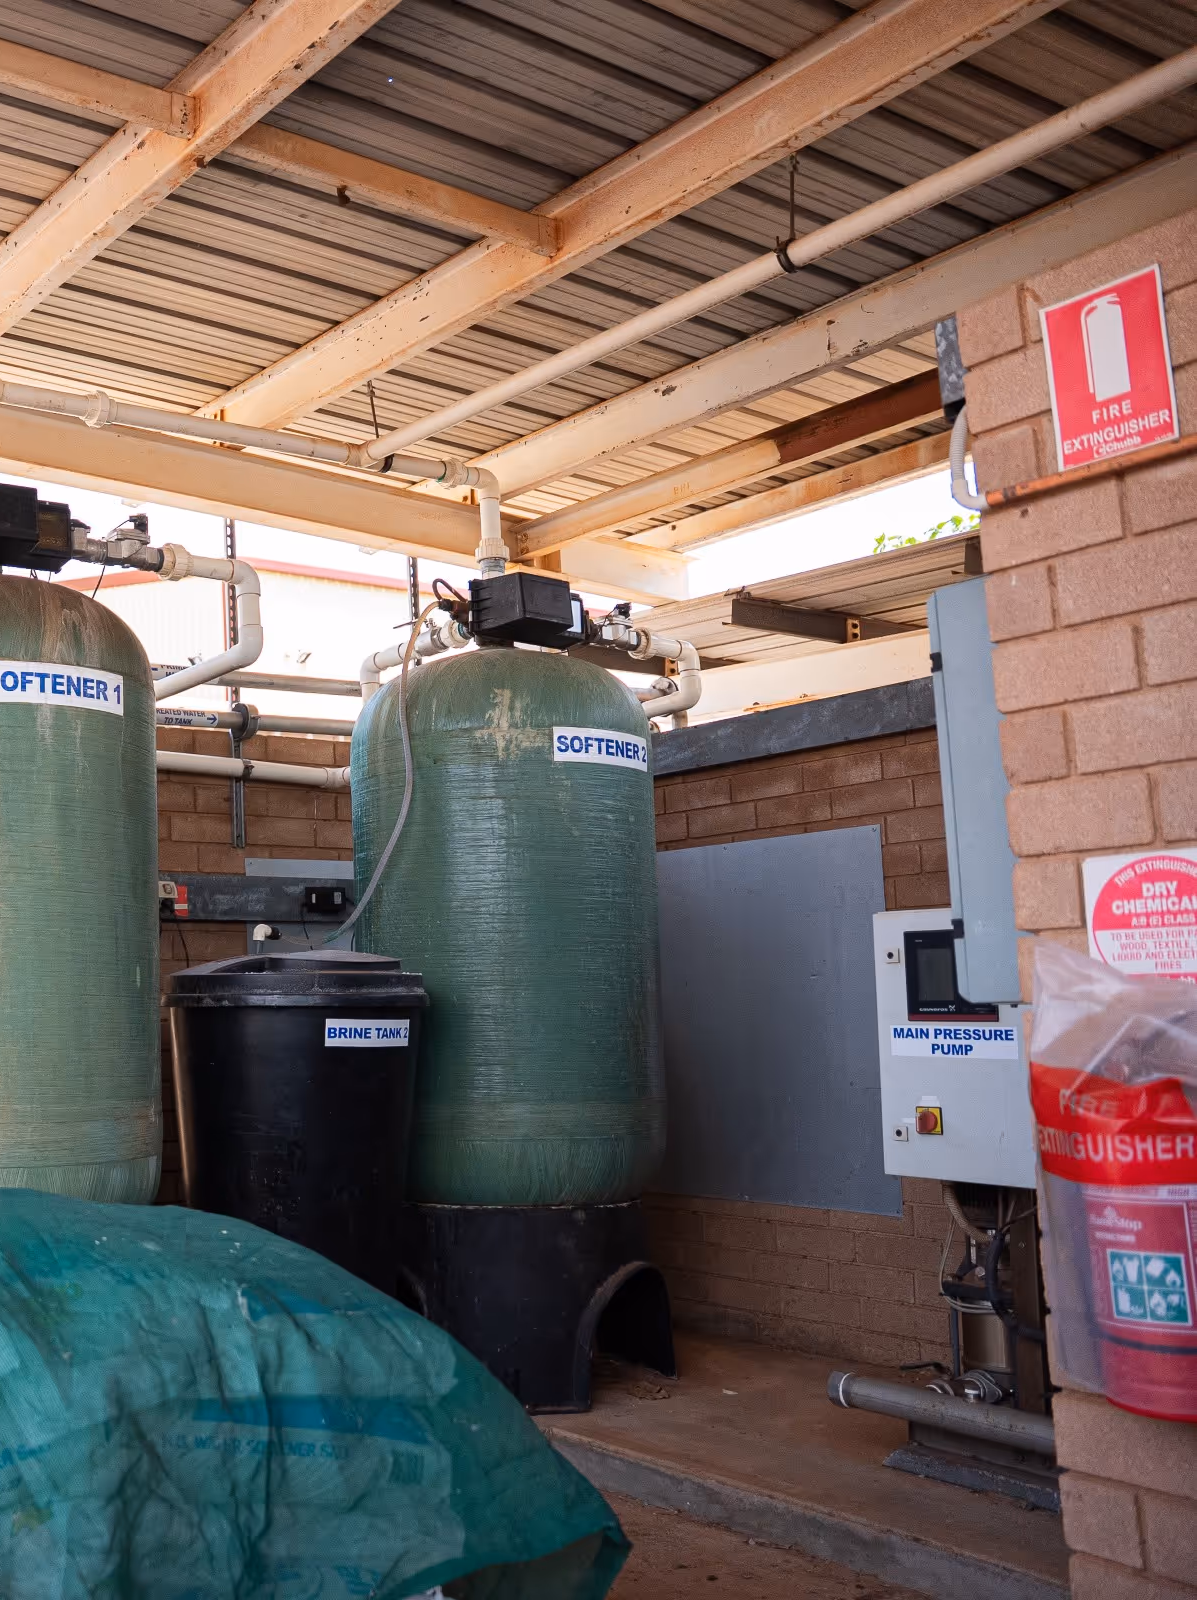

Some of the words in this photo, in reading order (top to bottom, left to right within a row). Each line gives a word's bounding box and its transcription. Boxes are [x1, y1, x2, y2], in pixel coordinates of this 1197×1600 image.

[1092, 399, 1133, 425] FIRE
[1063, 409, 1171, 455] EXTINGUISHER
[113, 684, 121, 705] 1
[156, 708, 181, 716] REATED
[183, 709, 206, 717] WATER
[174, 717, 193, 725] TANK
[556, 735, 640, 761] SOFTENER
[641, 745, 647, 764] 2
[1114, 867, 1136, 888] THIS
[1142, 880, 1178, 897] DRY
[1164, 913, 1196, 924] CLASS
[1110, 932, 1122, 941] TO
[1125, 931, 1136, 941] BE
[1139, 930, 1163, 940] USED
[1165, 929, 1184, 939] FOR
[1112, 952, 1142, 962] LIQUID
[1145, 951, 1164, 961] AND
[1154, 960, 1182, 970] FIRES
[327, 1027, 372, 1039] BRINE
[375, 1027, 402, 1039] TANK
[403, 1026, 408, 1039] 2
[893, 1027, 930, 1039] MAIN
[934, 1028, 1015, 1041] PRESSURE
[931, 1043, 974, 1056] PUMP
